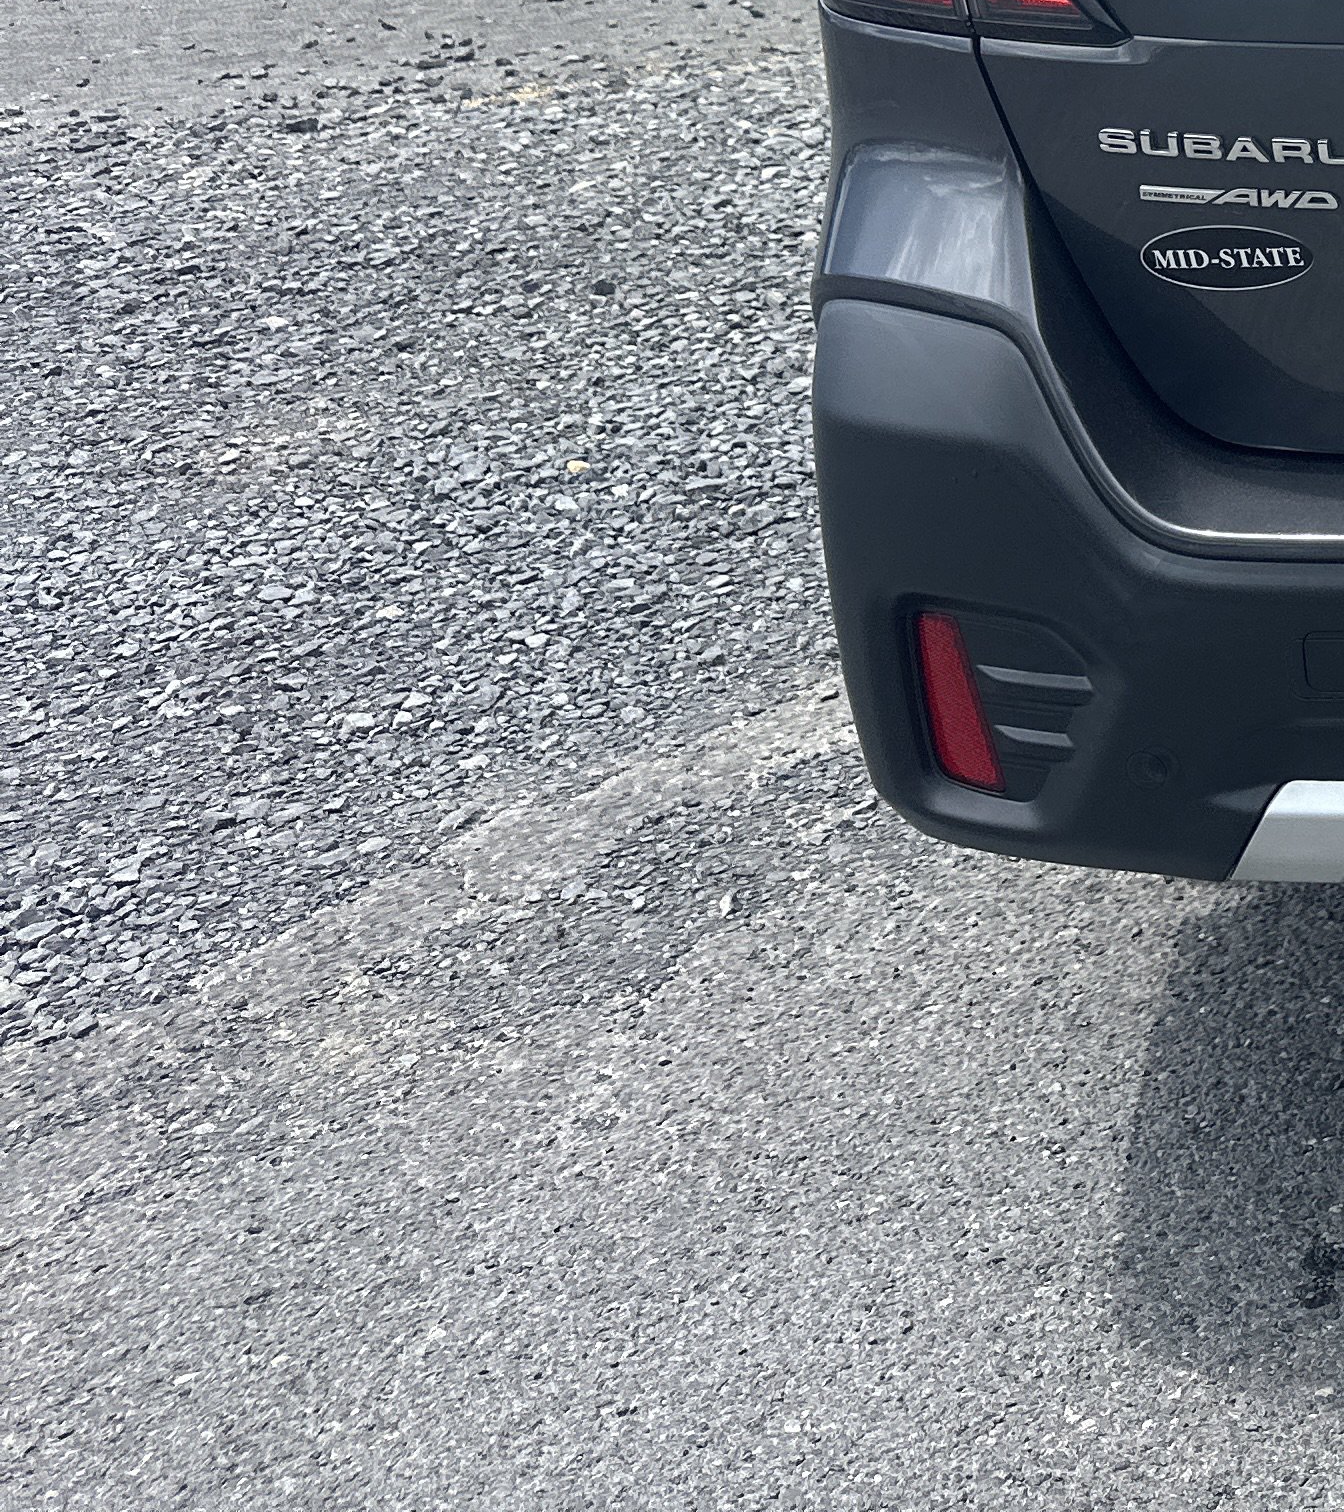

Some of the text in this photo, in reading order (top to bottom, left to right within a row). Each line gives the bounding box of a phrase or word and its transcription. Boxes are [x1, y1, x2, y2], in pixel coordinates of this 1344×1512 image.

[1141, 187, 1339, 210] SYMMETRICAL AWD
[1151, 246, 1305, 271] MID-STATE
